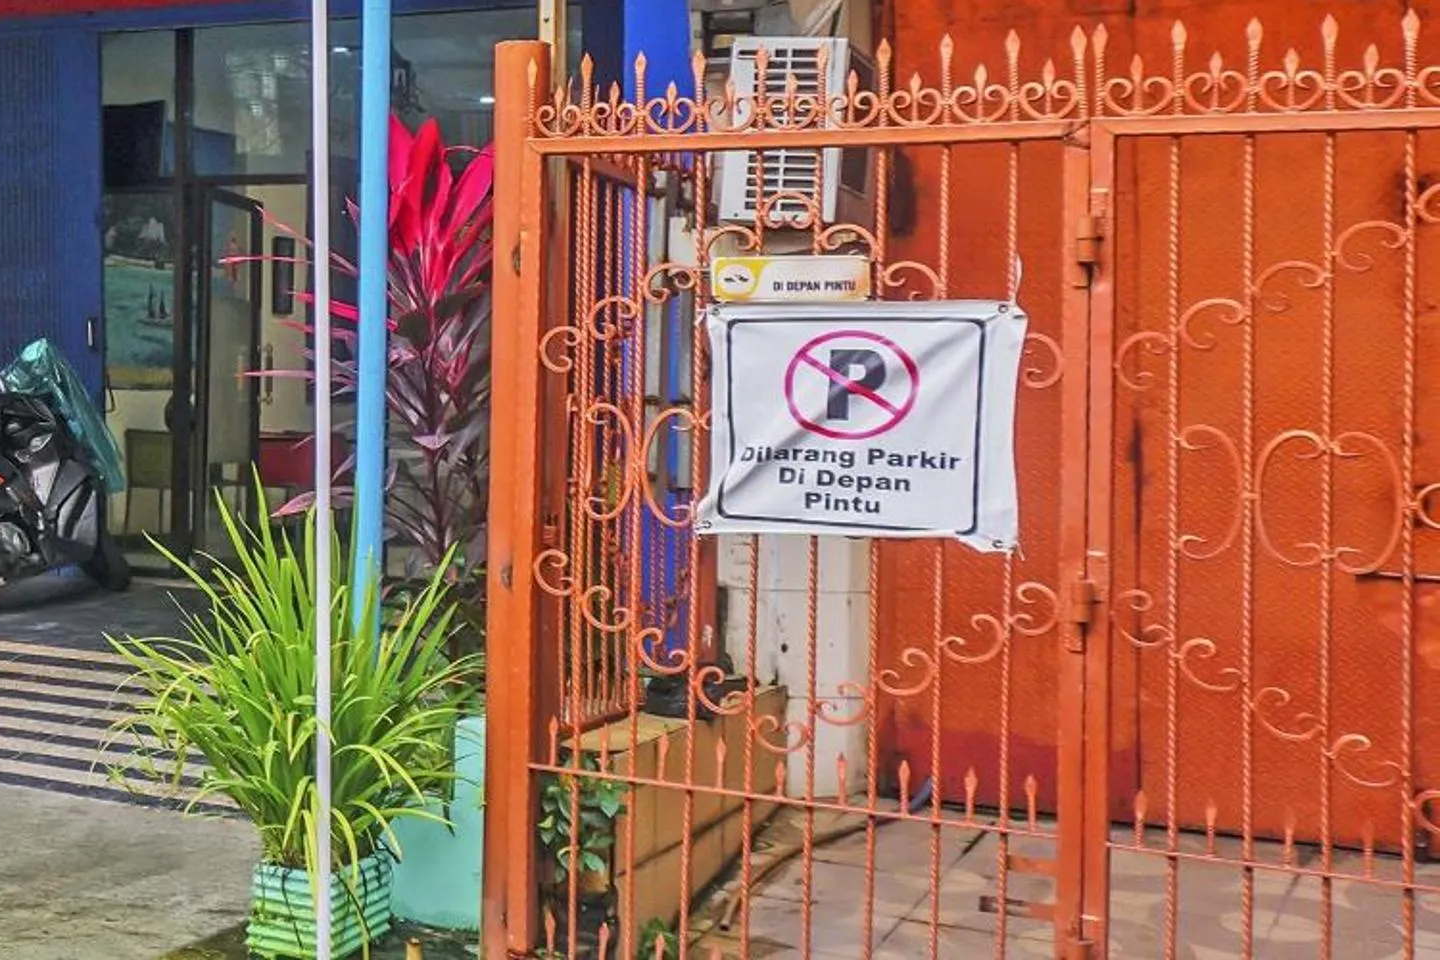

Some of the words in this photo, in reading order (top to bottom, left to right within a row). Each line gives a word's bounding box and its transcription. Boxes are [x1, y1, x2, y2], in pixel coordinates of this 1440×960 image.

[773, 281, 784, 291] DI
[787, 281, 820, 291] DEPAN
[825, 280, 856, 291] PINTU
[742, 446, 855, 469] Dilarang
[867, 448, 961, 469] Parkir
[779, 467, 804, 485] Di
[816, 469, 911, 493] Depan
[805, 493, 881, 514] Pintu
